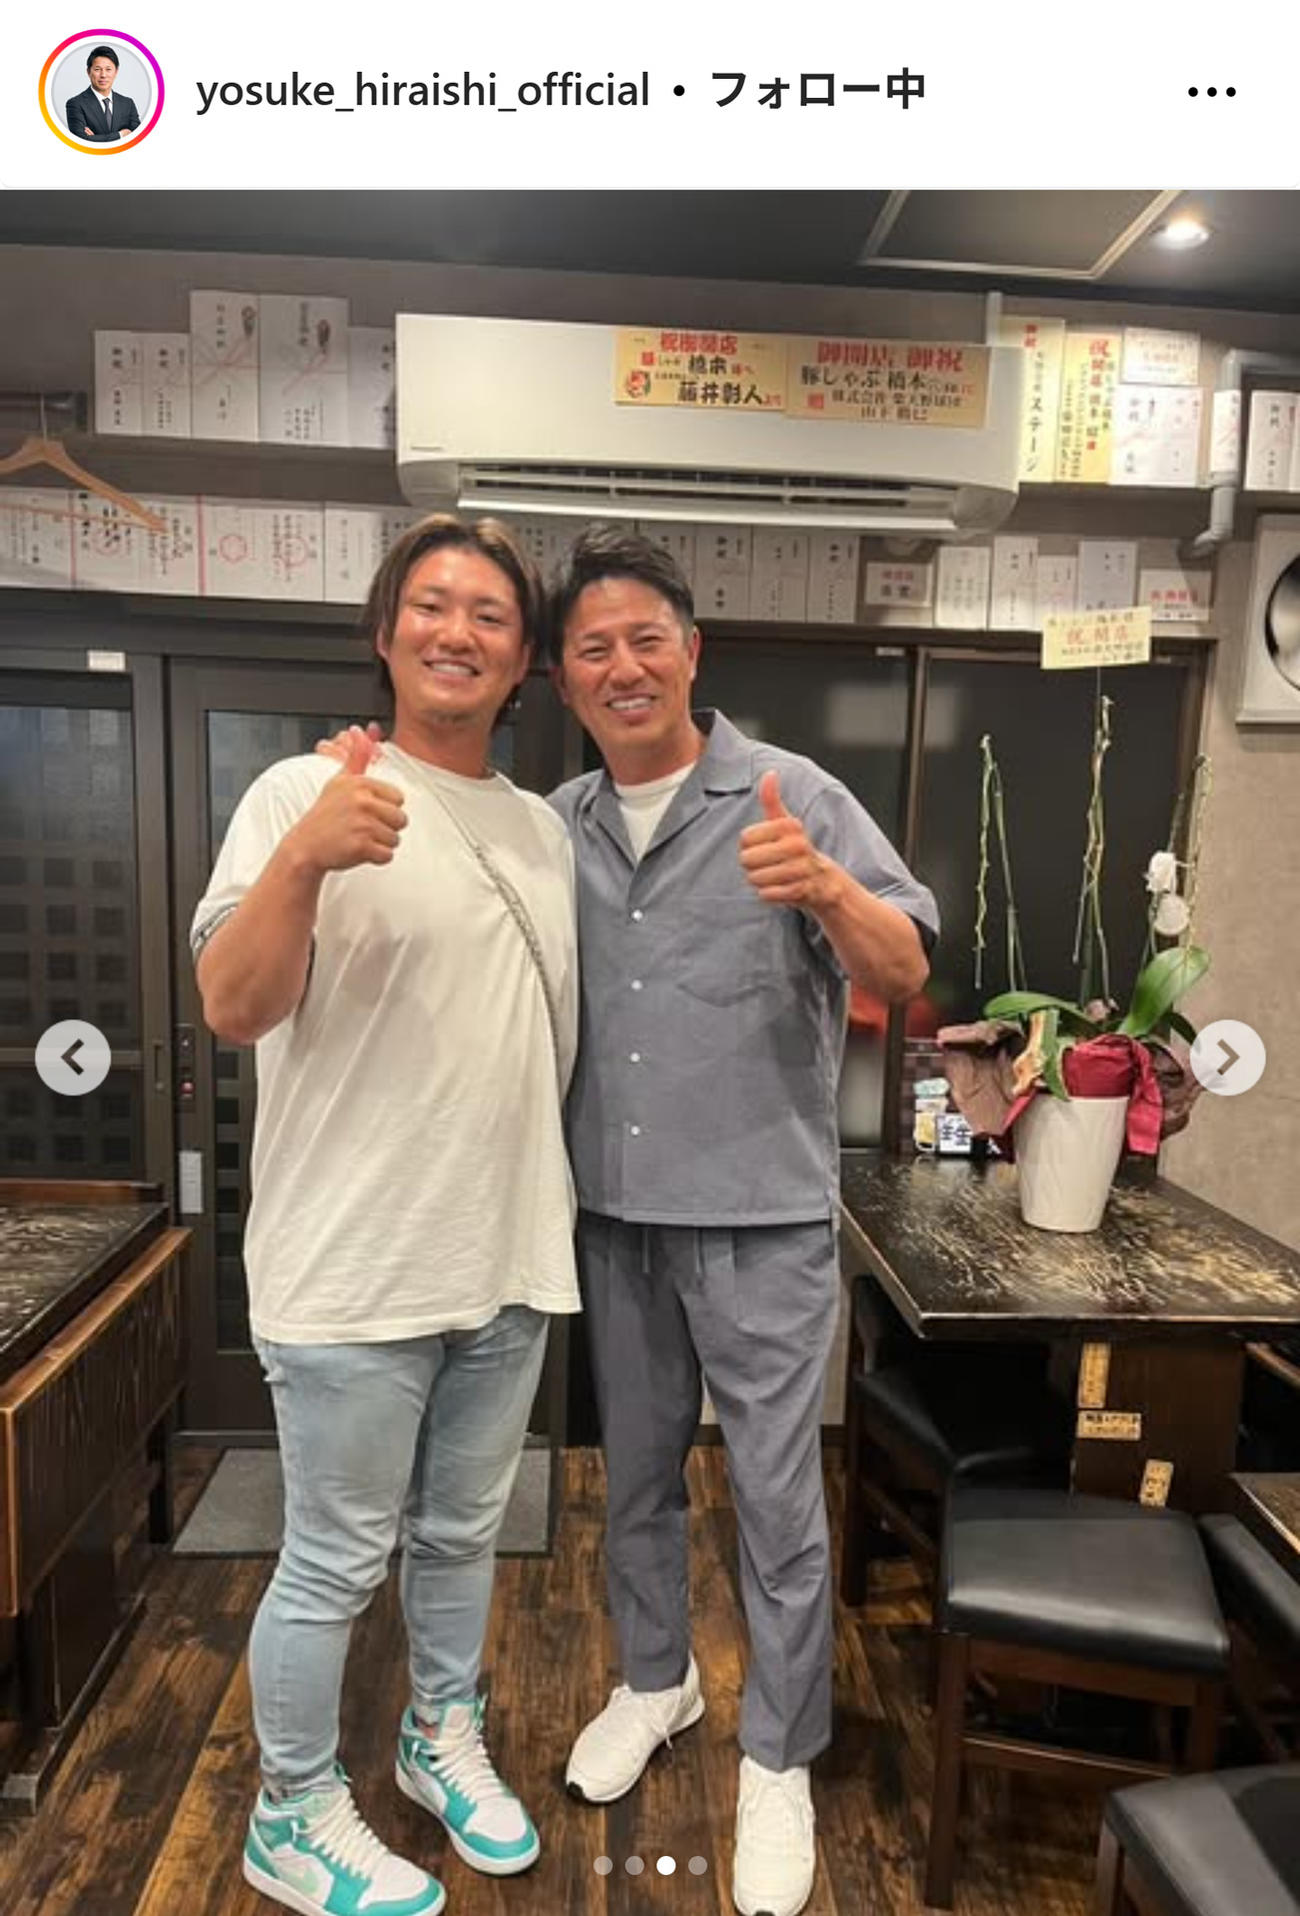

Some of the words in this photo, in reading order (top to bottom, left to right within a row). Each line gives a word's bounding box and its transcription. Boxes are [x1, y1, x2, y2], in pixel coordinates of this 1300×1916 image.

[906, 346, 963, 373] 御祝
[801, 365, 880, 389] 豚しゃぶ
